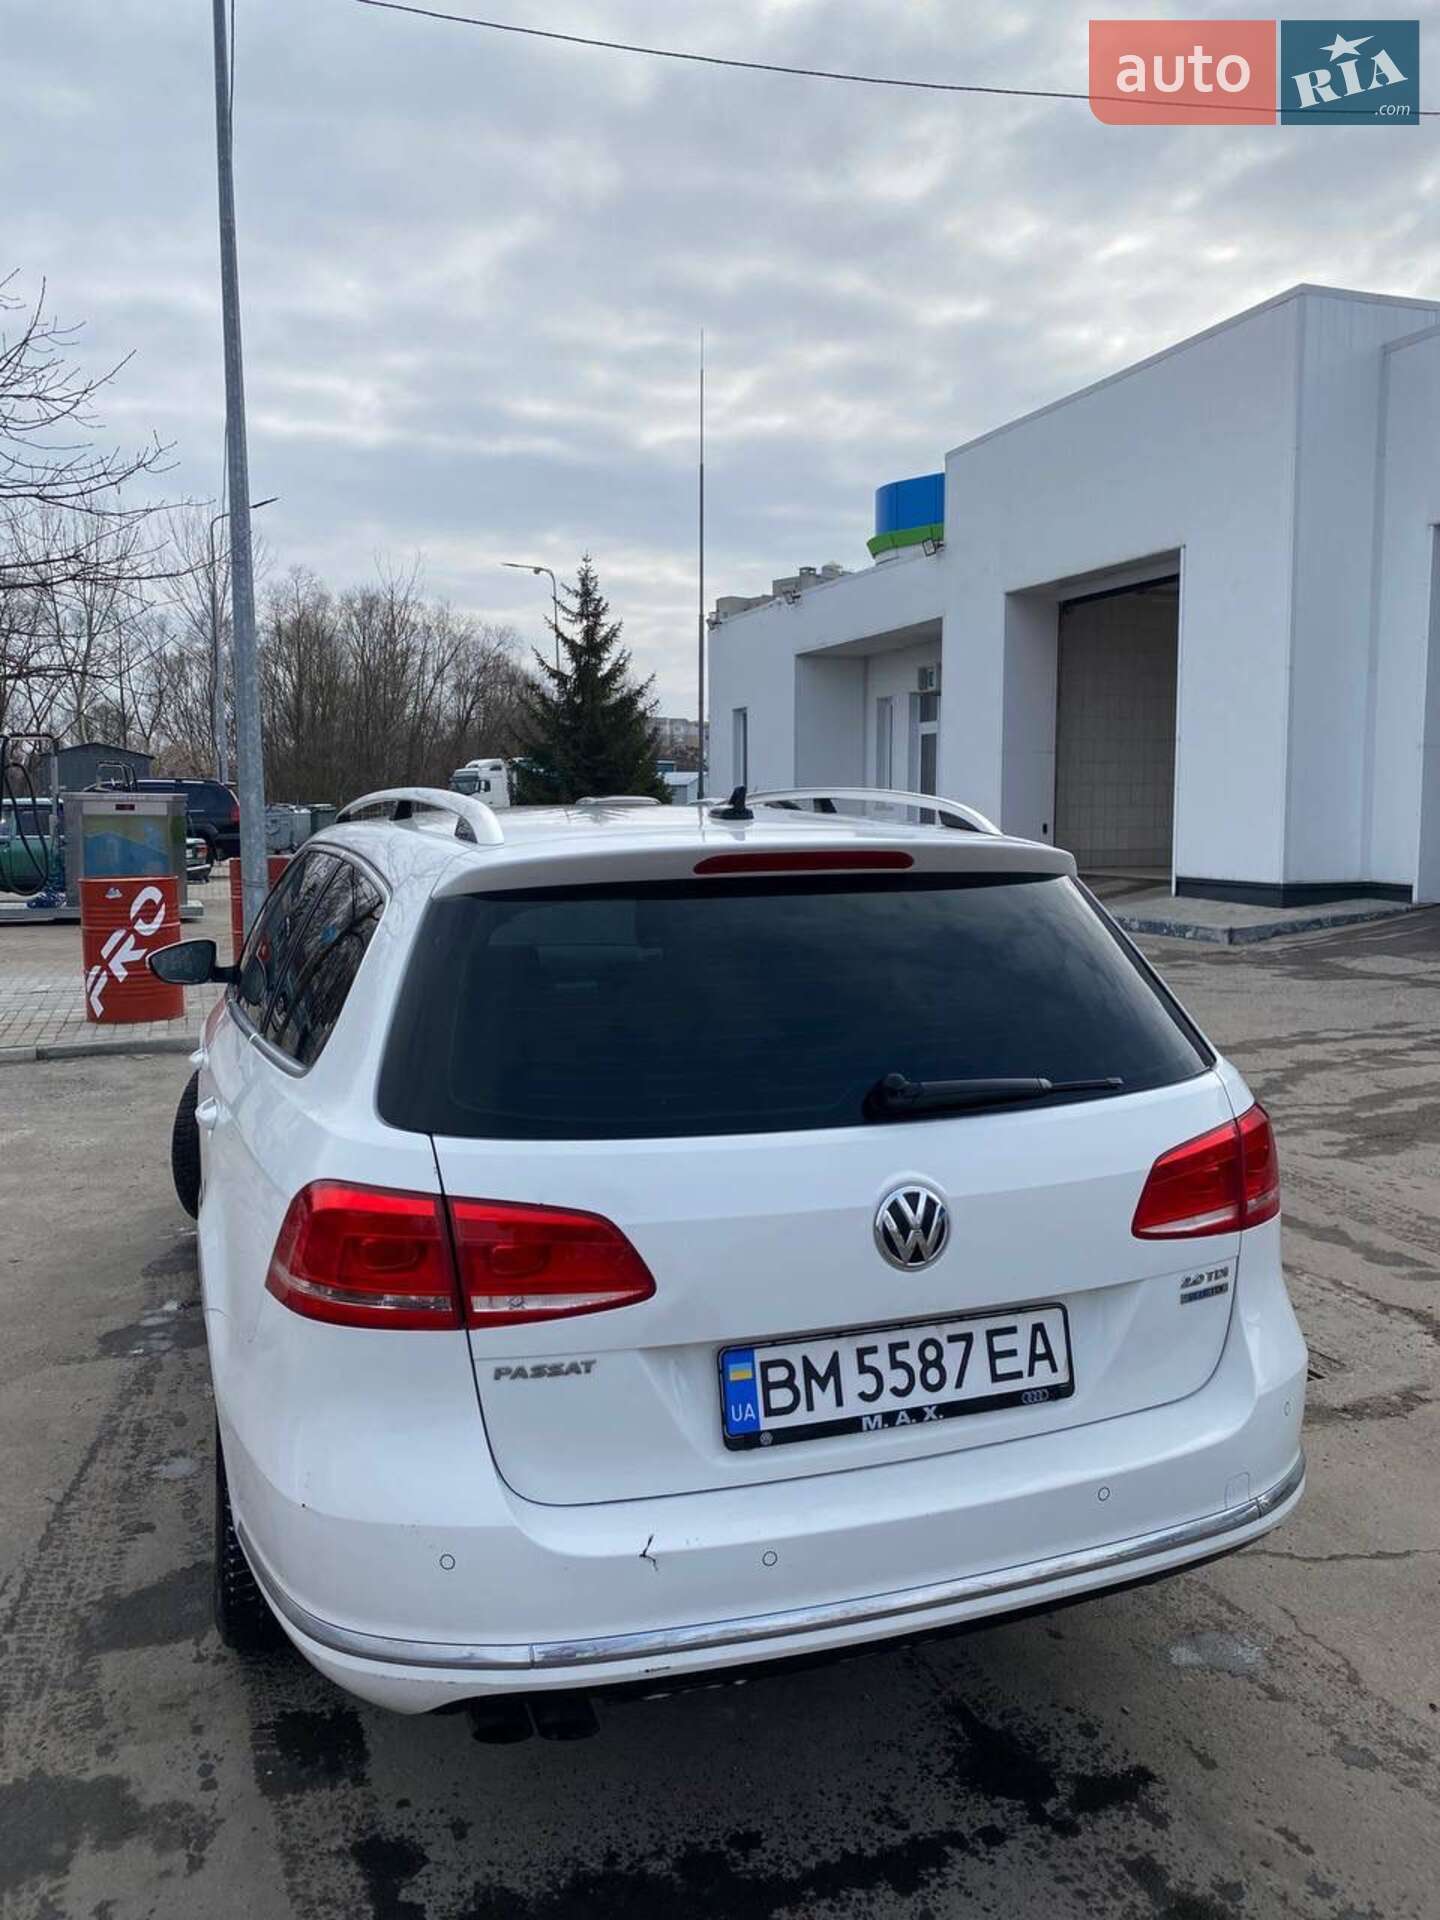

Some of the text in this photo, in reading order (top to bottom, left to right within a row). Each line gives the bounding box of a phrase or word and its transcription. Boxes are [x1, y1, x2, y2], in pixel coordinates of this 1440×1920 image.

[493, 1359, 596, 1380] PASSAT
[759, 1322, 1058, 1418] BM 5587 EA
[731, 1403, 756, 1422] UA
